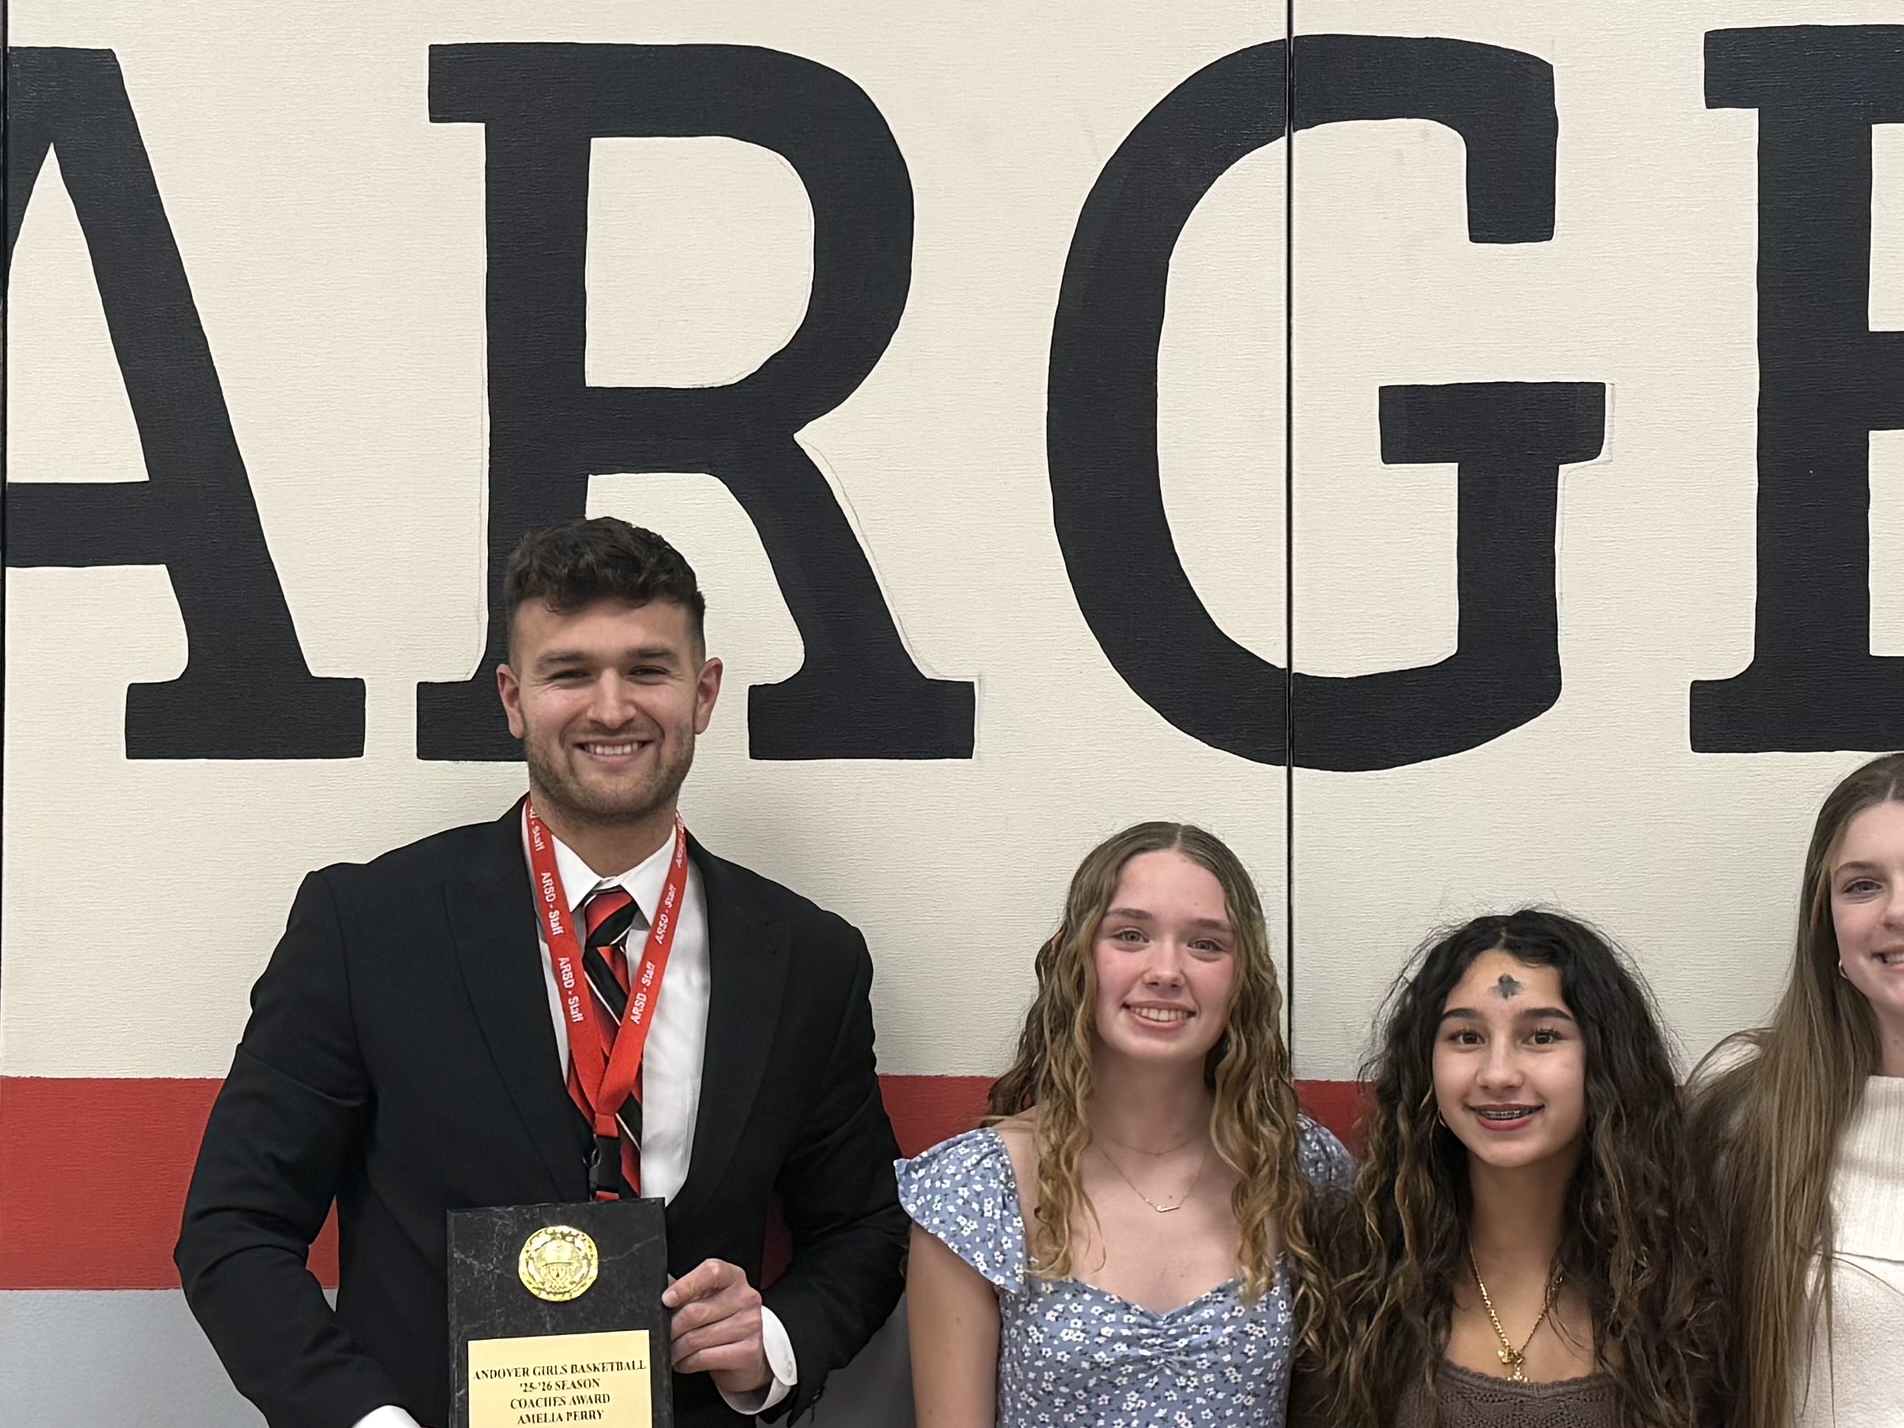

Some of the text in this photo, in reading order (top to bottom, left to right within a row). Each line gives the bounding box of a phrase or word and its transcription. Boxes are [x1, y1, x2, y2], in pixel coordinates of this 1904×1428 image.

[548, 909, 565, 936] Staff
[558, 957, 575, 989] ARSD
[568, 995, 584, 1023] Staff
[630, 992, 647, 1025] ARSD
[641, 960, 655, 987] Staff
[473, 1360, 647, 1380] ANDOVER GIRLS BASKETBALL
[554, 1378, 601, 1391] SEASON
[510, 1393, 611, 1410] COACHES AWARD
[517, 1409, 604, 1425] AMELIA PERRY
